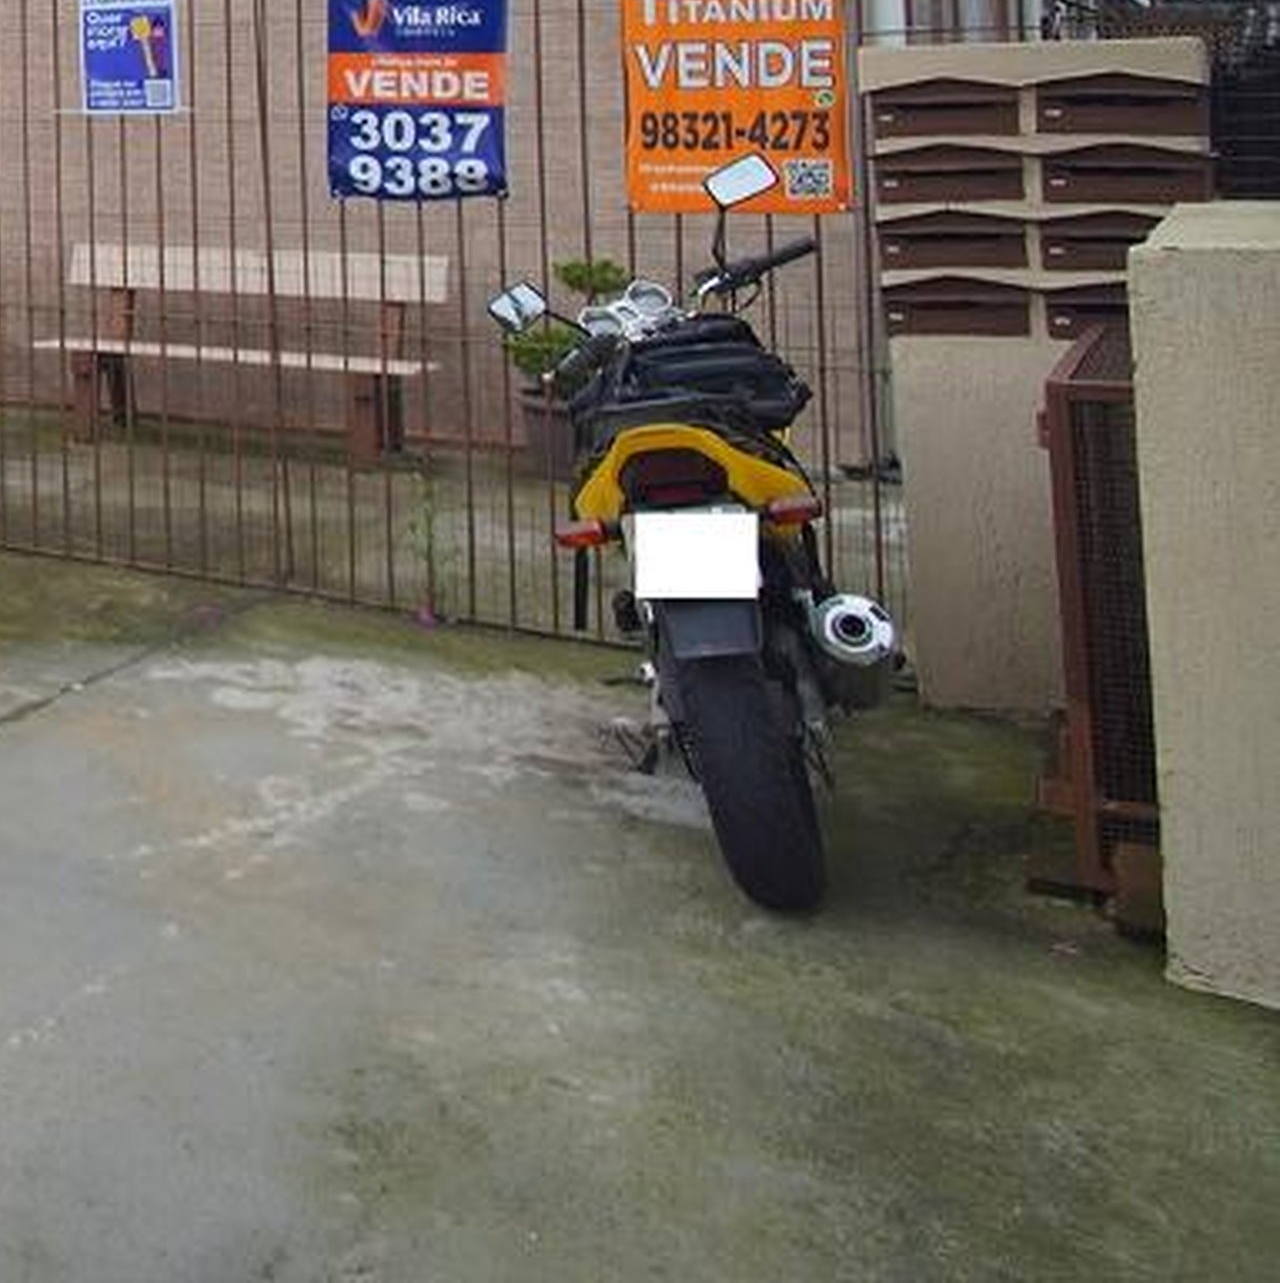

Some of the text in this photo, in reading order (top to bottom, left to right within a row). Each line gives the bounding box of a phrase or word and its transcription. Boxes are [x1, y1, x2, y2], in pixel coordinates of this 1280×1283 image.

[392, 6, 482, 26] Vila Rica
[635, 39, 834, 89] VENDE
[345, 70, 488, 99] VENDE
[350, 110, 490, 153] 3037
[641, 111, 830, 150] 98321-4273
